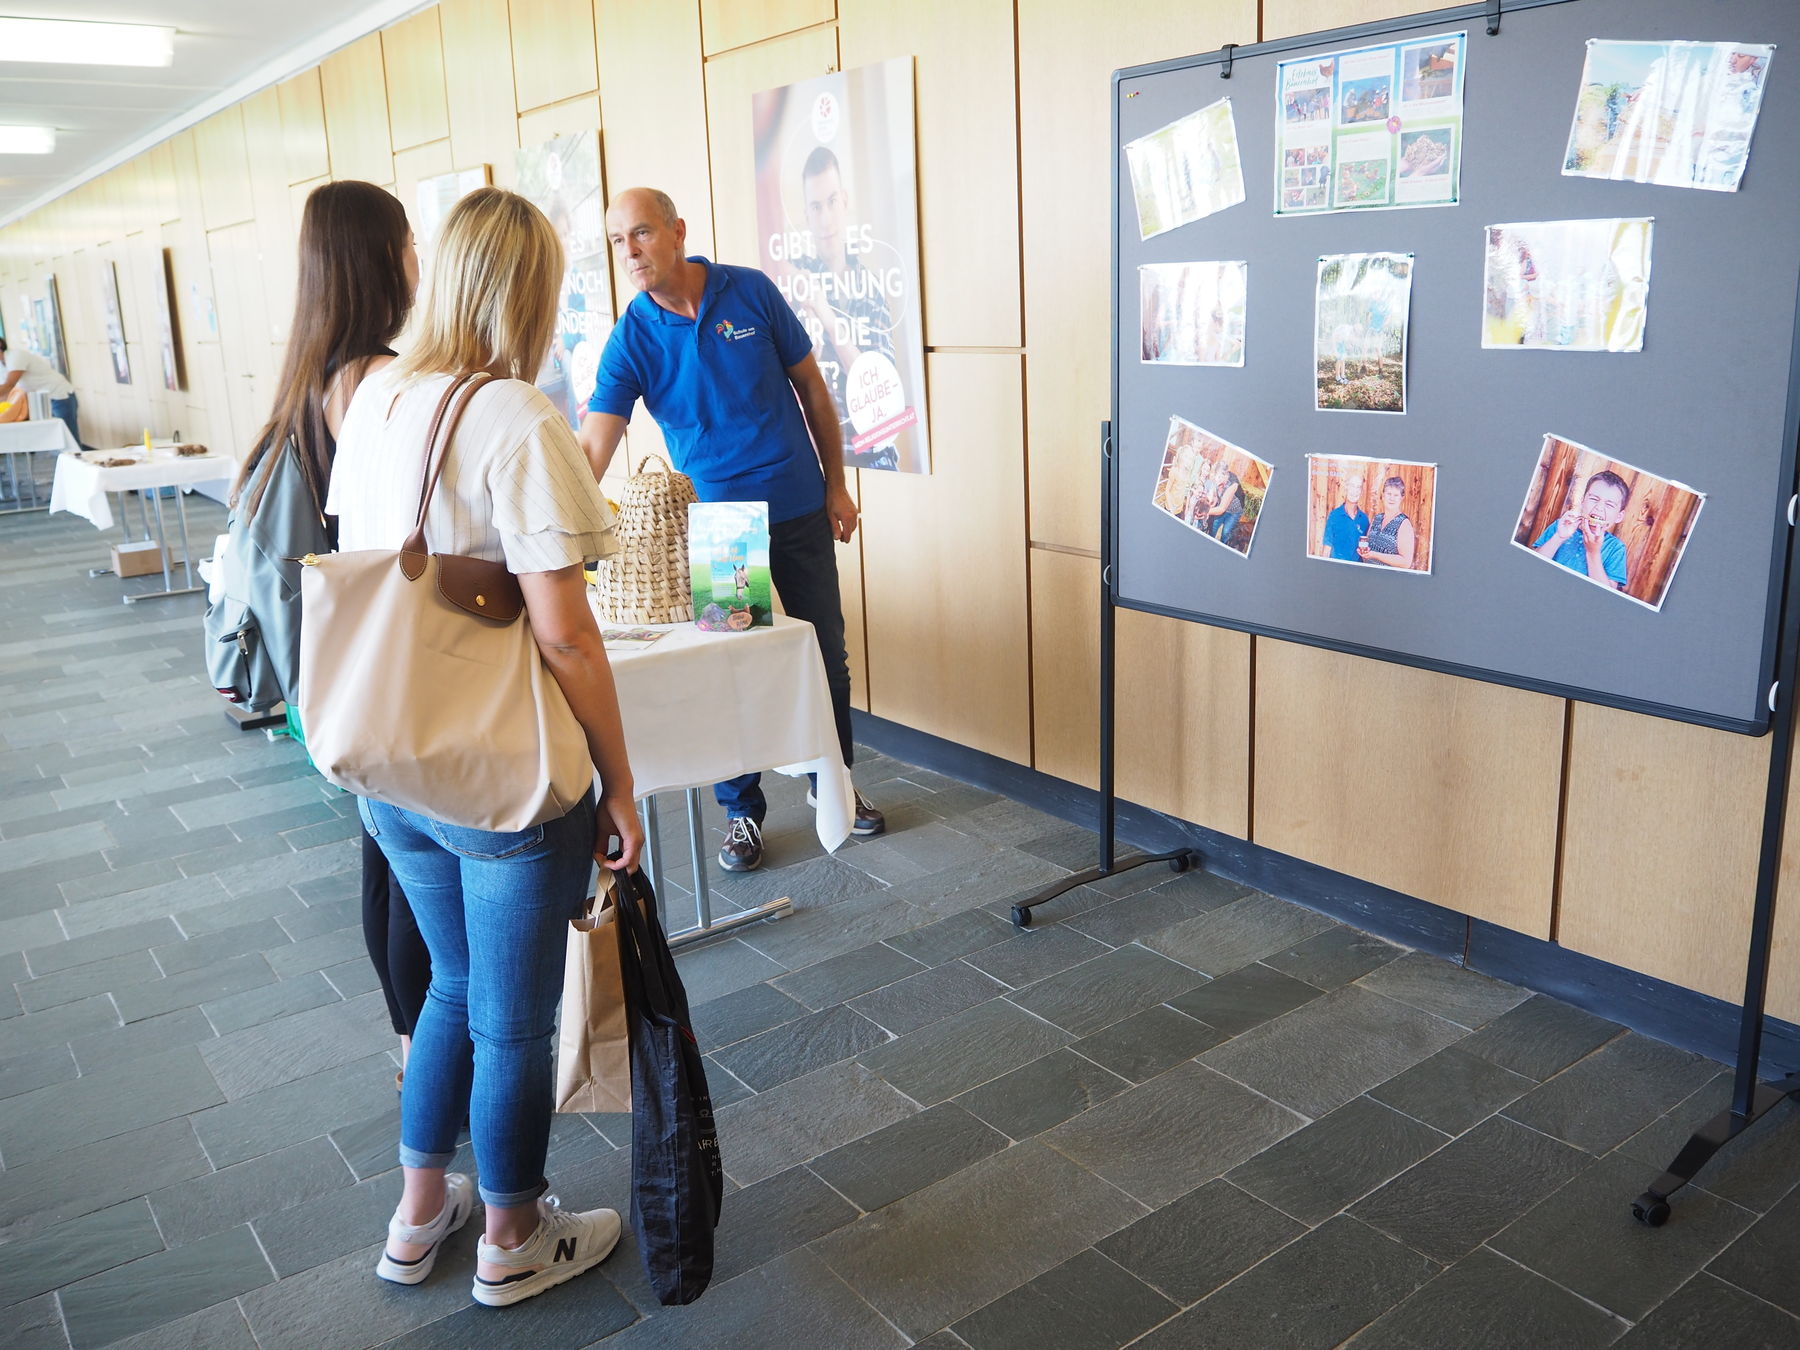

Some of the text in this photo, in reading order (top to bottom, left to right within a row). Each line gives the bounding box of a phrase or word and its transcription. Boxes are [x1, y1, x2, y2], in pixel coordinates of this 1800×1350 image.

[769, 224, 873, 261] GIBT ES
[568, 271, 603, 294] NOCH
[777, 267, 903, 303] HOFFNUNG
[835, 316, 872, 346] DIE
[859, 366, 878, 389] ICH
[553, 1237, 577, 1263] N
